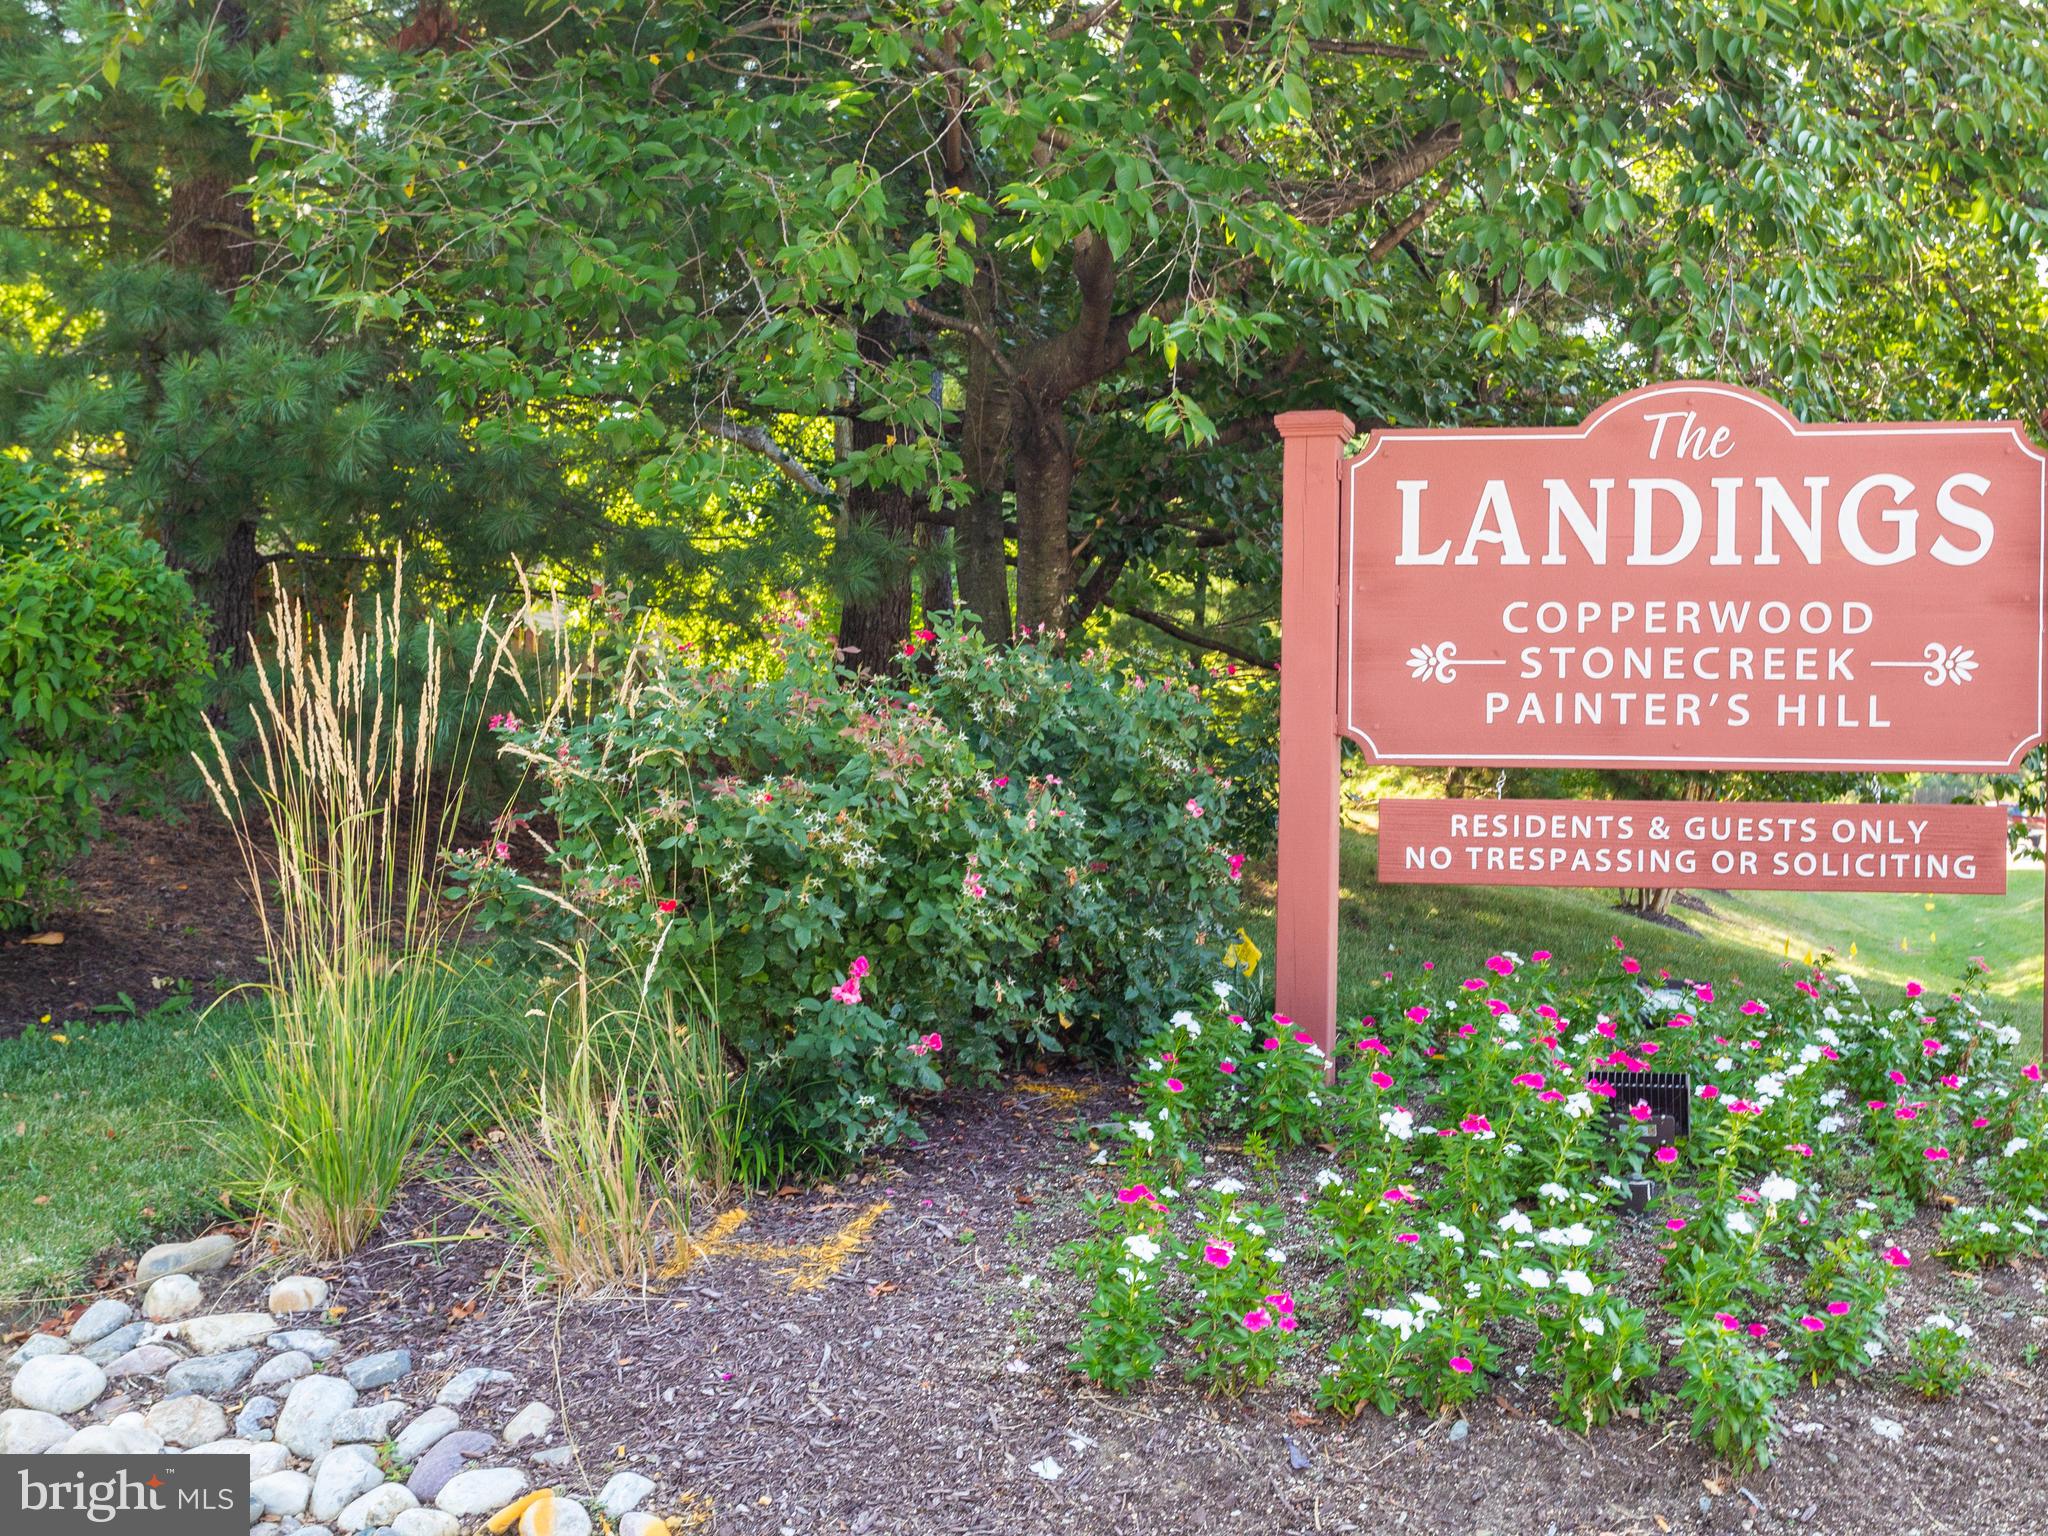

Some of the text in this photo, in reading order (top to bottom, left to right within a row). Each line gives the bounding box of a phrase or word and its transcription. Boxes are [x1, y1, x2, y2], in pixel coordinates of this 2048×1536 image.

[1643, 410, 1736, 461] The
[1394, 472, 1995, 566] LANDINGS
[1502, 600, 1873, 635] COPPERWOOD
[1520, 646, 1855, 681] STONECREEK
[1486, 691, 1891, 728] PAINTER'S HILL
[1451, 814, 1929, 844] RESIDENTS & GUESTS ONLY
[1405, 846, 1976, 879] NO TRESPASSING OR SOLICITING
